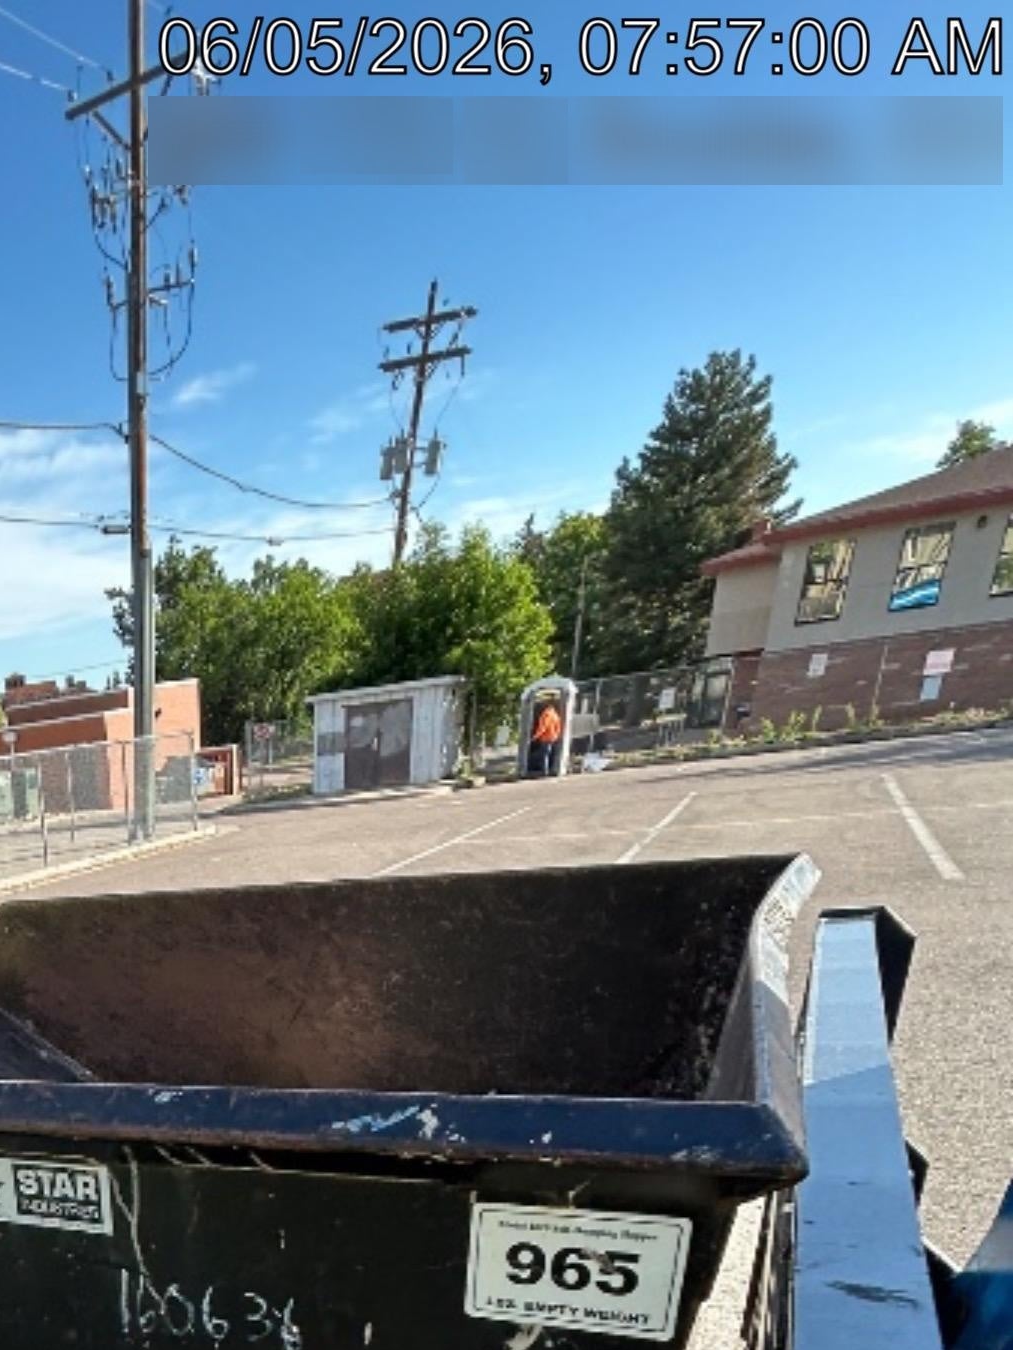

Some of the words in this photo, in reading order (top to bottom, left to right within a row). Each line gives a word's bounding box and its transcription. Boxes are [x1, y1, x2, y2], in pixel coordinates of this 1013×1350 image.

[17, 1169, 99, 1201] STAR
[505, 1241, 642, 1296] 965
[523, 1301, 579, 1317] EMPTY
